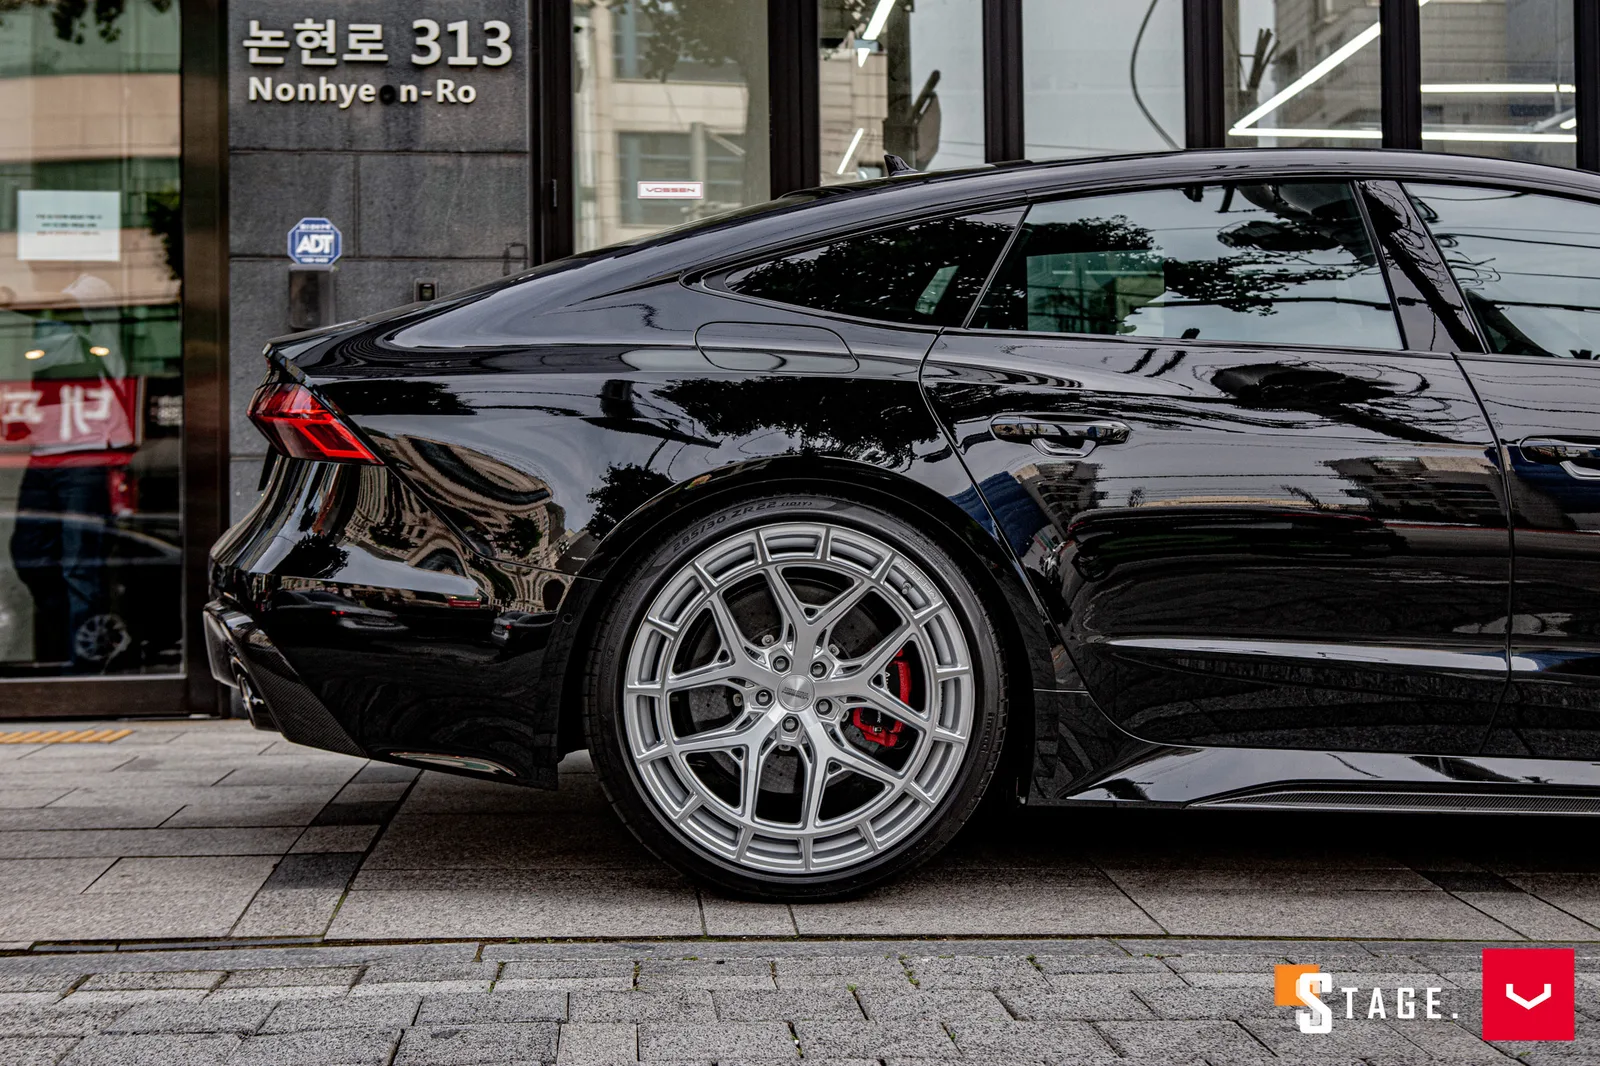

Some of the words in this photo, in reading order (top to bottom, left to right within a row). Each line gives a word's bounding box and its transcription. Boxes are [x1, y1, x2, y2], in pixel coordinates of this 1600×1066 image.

[243, 18, 388, 65] 논현로
[411, 19, 513, 66] 313
[296, 234, 335, 254] ADT
[673, 515, 727, 553] 285/30
[730, 501, 778, 519] ZR22
